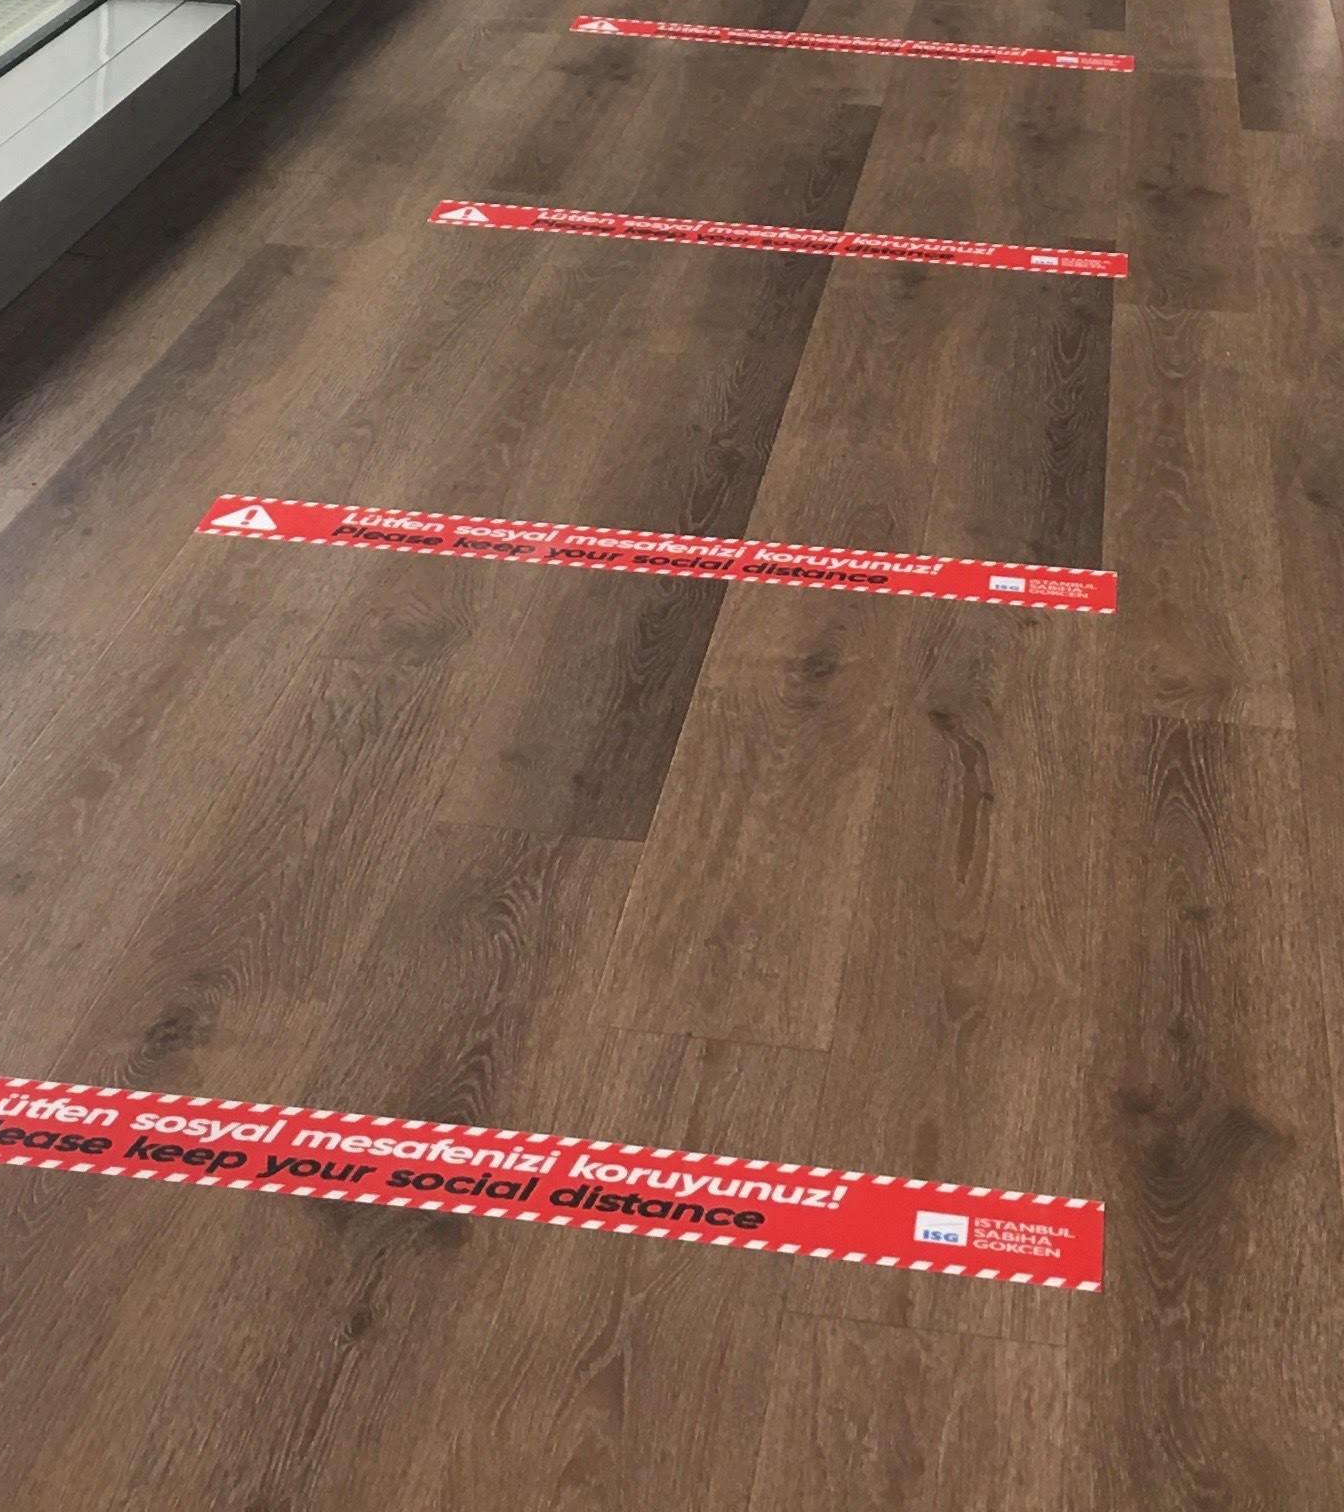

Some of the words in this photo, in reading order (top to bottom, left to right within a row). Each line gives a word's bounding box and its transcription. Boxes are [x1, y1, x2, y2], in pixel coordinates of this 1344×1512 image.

[331, 525, 443, 546] Please
[452, 537, 535, 556] keep
[544, 548, 624, 562] your
[632, 553, 734, 571] social
[742, 559, 888, 584] distance
[341, 512, 445, 532] Lütfen
[453, 525, 560, 543] sosyal
[564, 534, 746, 559] mesafenizi
[754, 548, 944, 575] koruyunuz!
[123, 1135, 247, 1175] keep
[256, 1153, 377, 1183] your
[386, 1168, 541, 1202] social
[549, 1185, 766, 1230] distance
[129, 1112, 288, 1144] sosyal
[291, 1128, 561, 1175] mesafenizi
[568, 1153, 848, 1210] koruyunuz!
